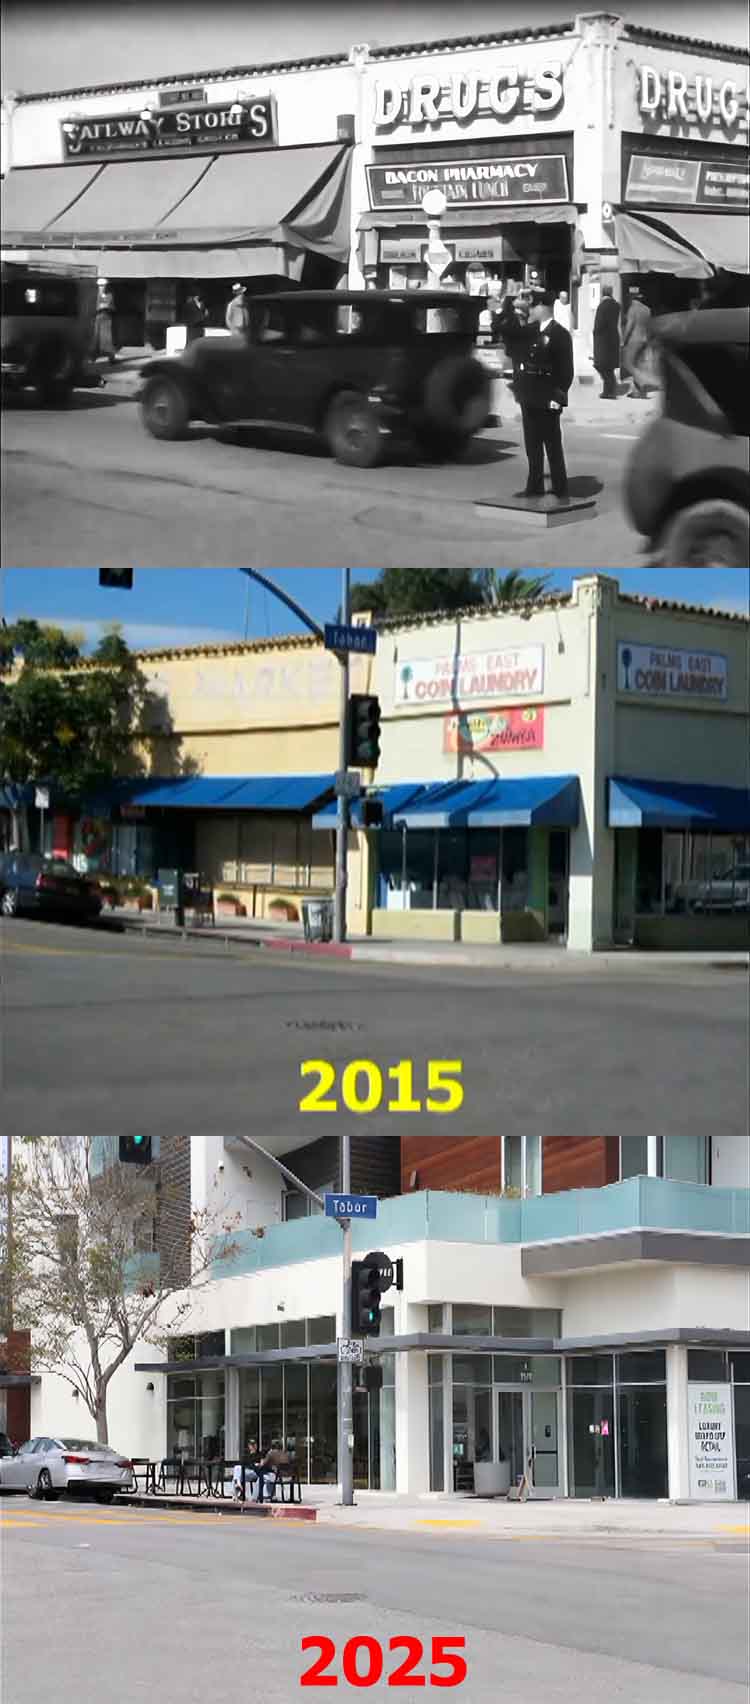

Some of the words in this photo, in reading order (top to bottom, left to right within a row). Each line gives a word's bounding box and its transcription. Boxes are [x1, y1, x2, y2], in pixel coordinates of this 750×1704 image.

[373, 62, 565, 126] DRUGS
[640, 65, 750, 127] DRUG
[385, 169, 438, 184] BACON
[444, 163, 538, 181] PHARMACY
[415, 677, 455, 698] COIN
[459, 669, 537, 695] LAUNDRY
[333, 1199, 367, 1214] Tabor
